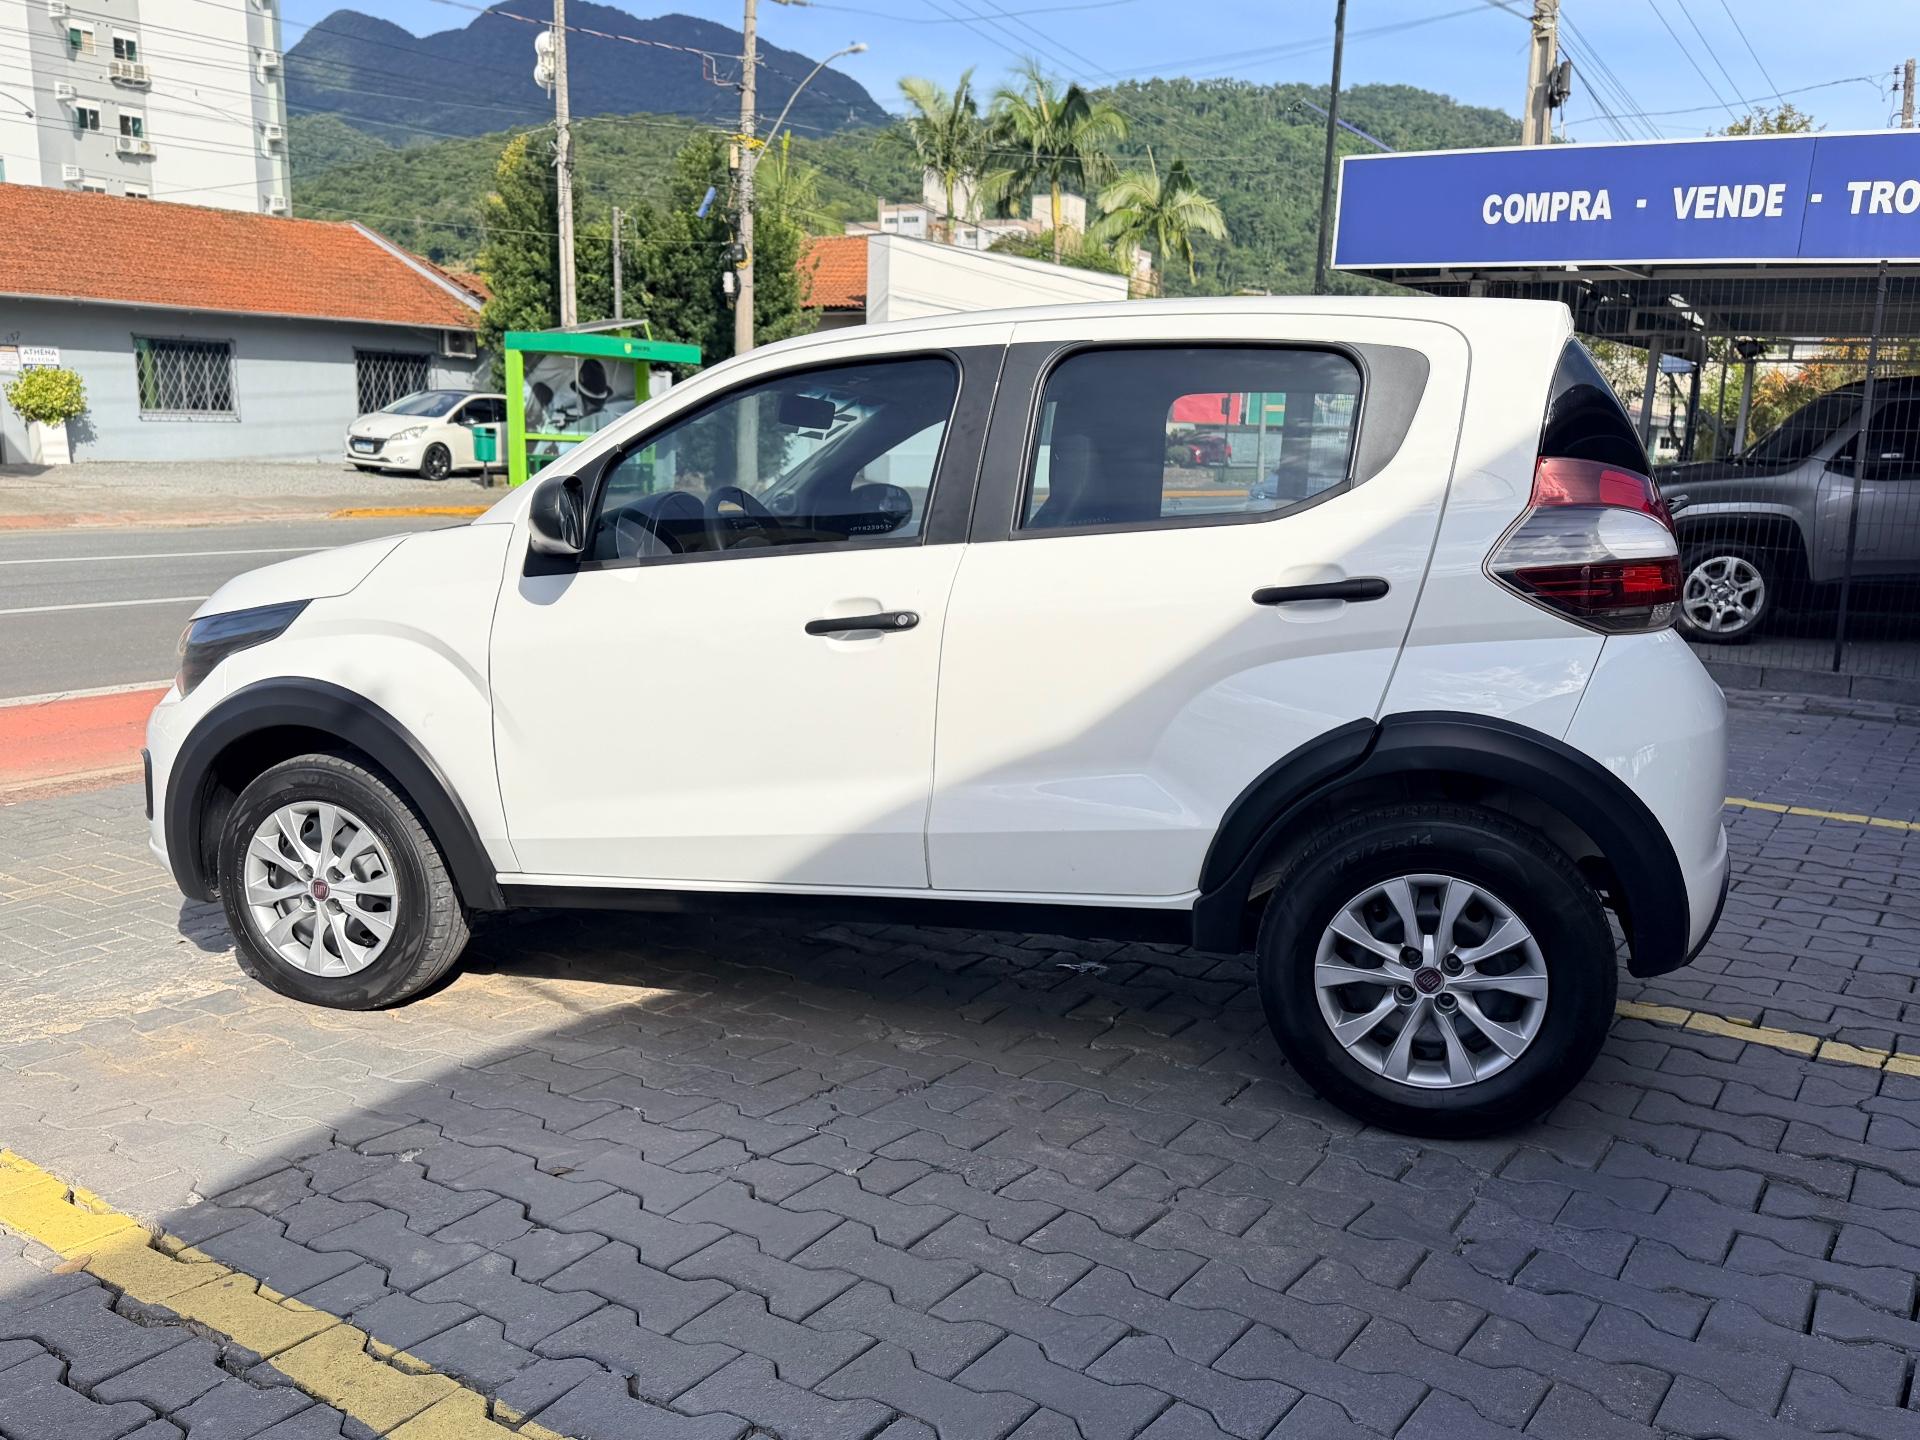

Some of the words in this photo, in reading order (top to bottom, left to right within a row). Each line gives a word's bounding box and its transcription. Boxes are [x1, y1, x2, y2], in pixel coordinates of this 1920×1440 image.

[1482, 189, 1612, 225] COMPRA
[1673, 183, 1786, 219] VENDE
[1847, 179, 1920, 215] TRO
[23, 348, 57, 356] ATHENA
